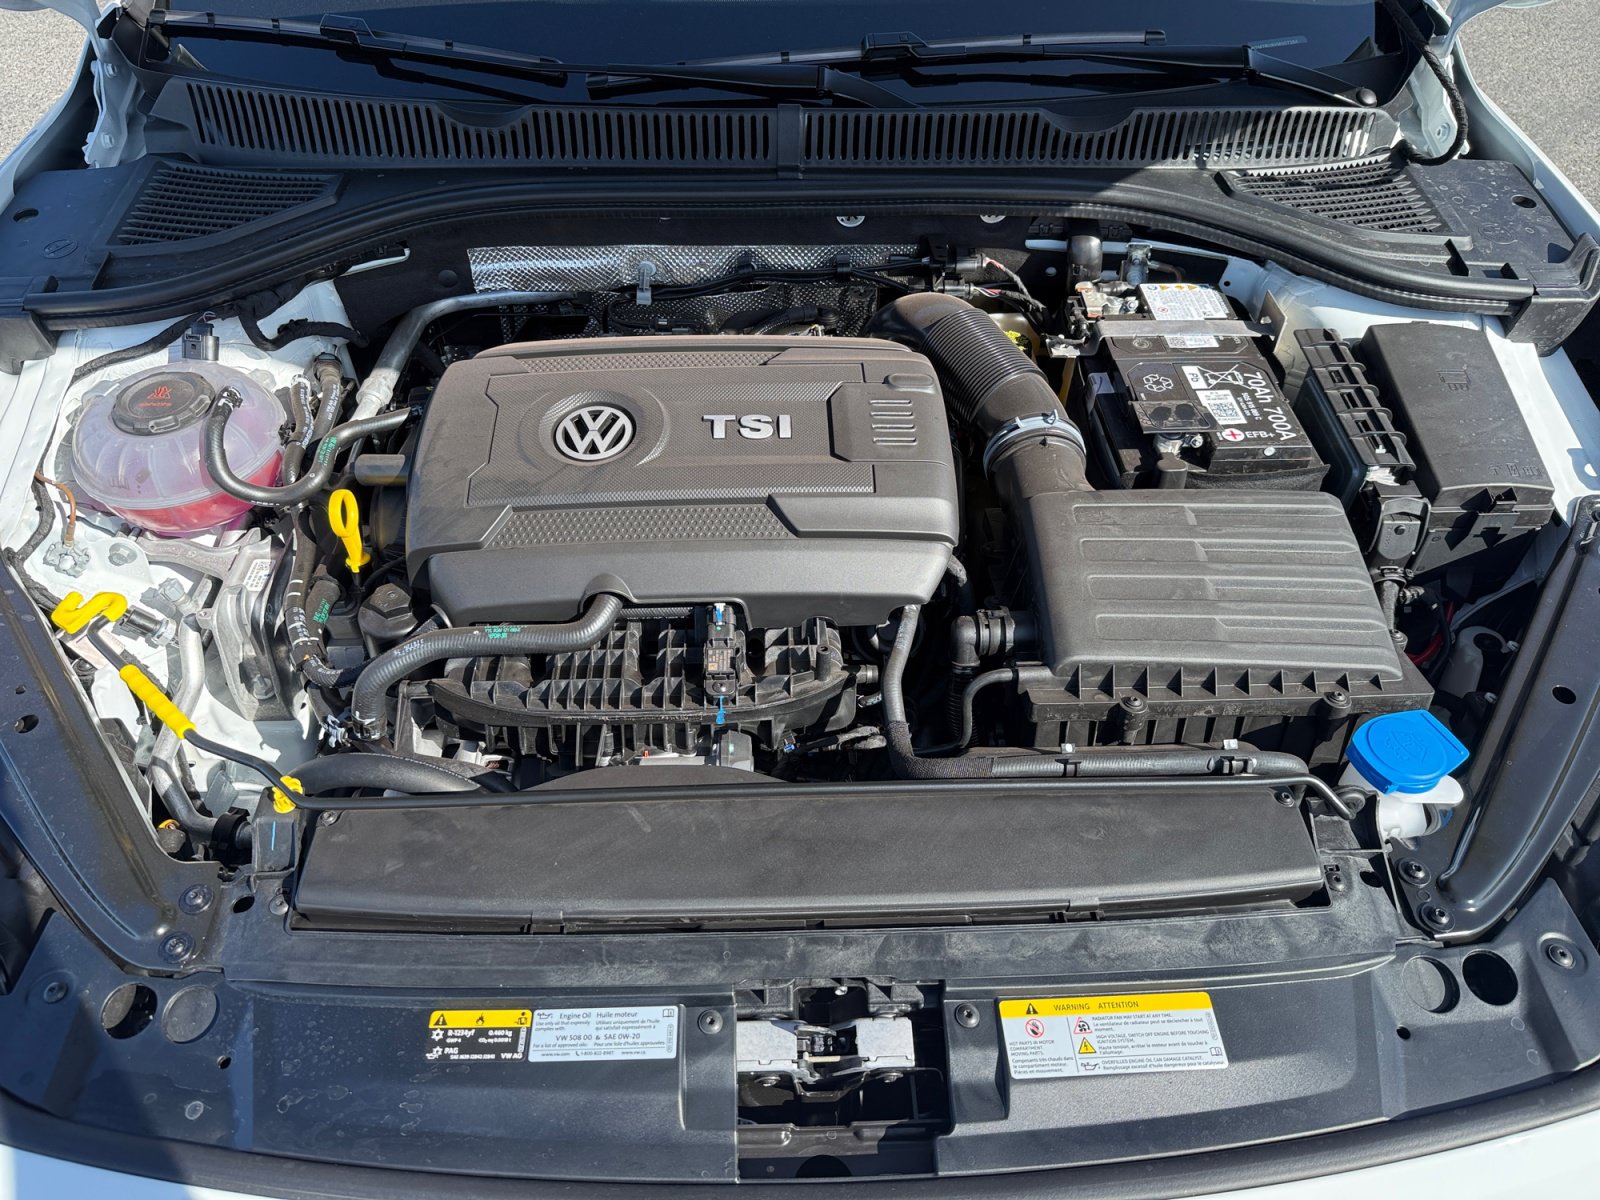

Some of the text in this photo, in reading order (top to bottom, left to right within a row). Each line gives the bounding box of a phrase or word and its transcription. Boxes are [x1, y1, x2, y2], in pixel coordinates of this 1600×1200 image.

[1189, 372, 1199, 382] Pb
[1244, 372, 1296, 440] 70Ah 700A
[556, 406, 633, 460] VW
[702, 414, 791, 439] TSI
[1098, 1001, 1139, 1009] ATTENTION
[447, 1029, 475, 1038] R-1234yf
